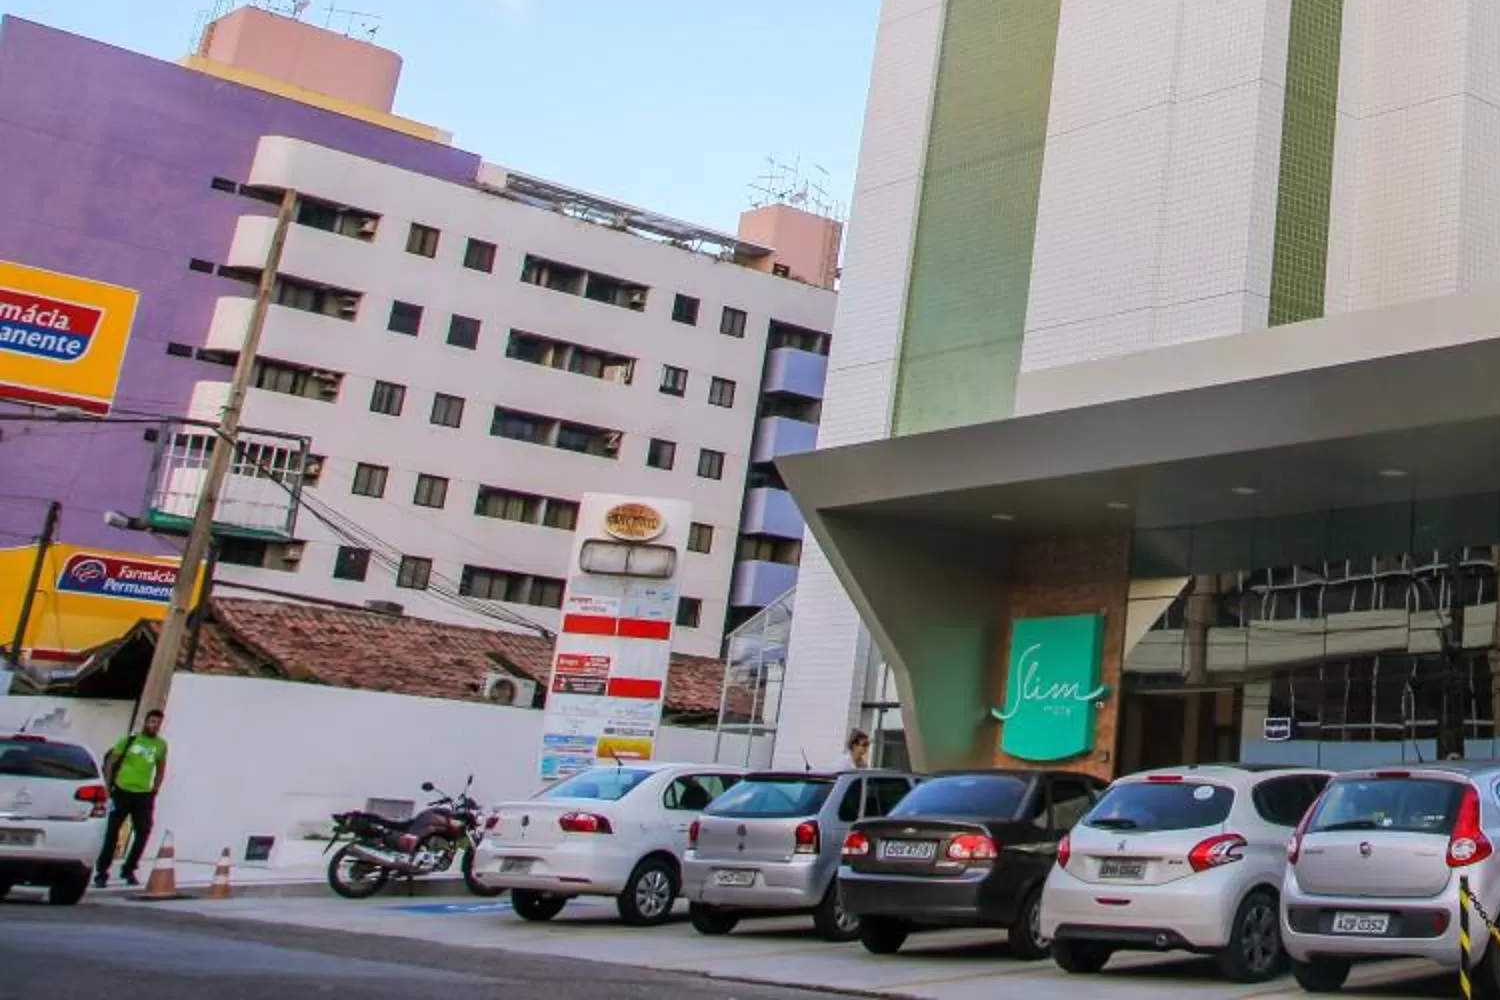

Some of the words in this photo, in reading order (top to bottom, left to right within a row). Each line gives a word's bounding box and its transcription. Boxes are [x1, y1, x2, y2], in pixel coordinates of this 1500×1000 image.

[118, 565, 176, 583] Farmácia
[103, 577, 175, 597] Permanent
[991, 643, 1105, 719] Slim
